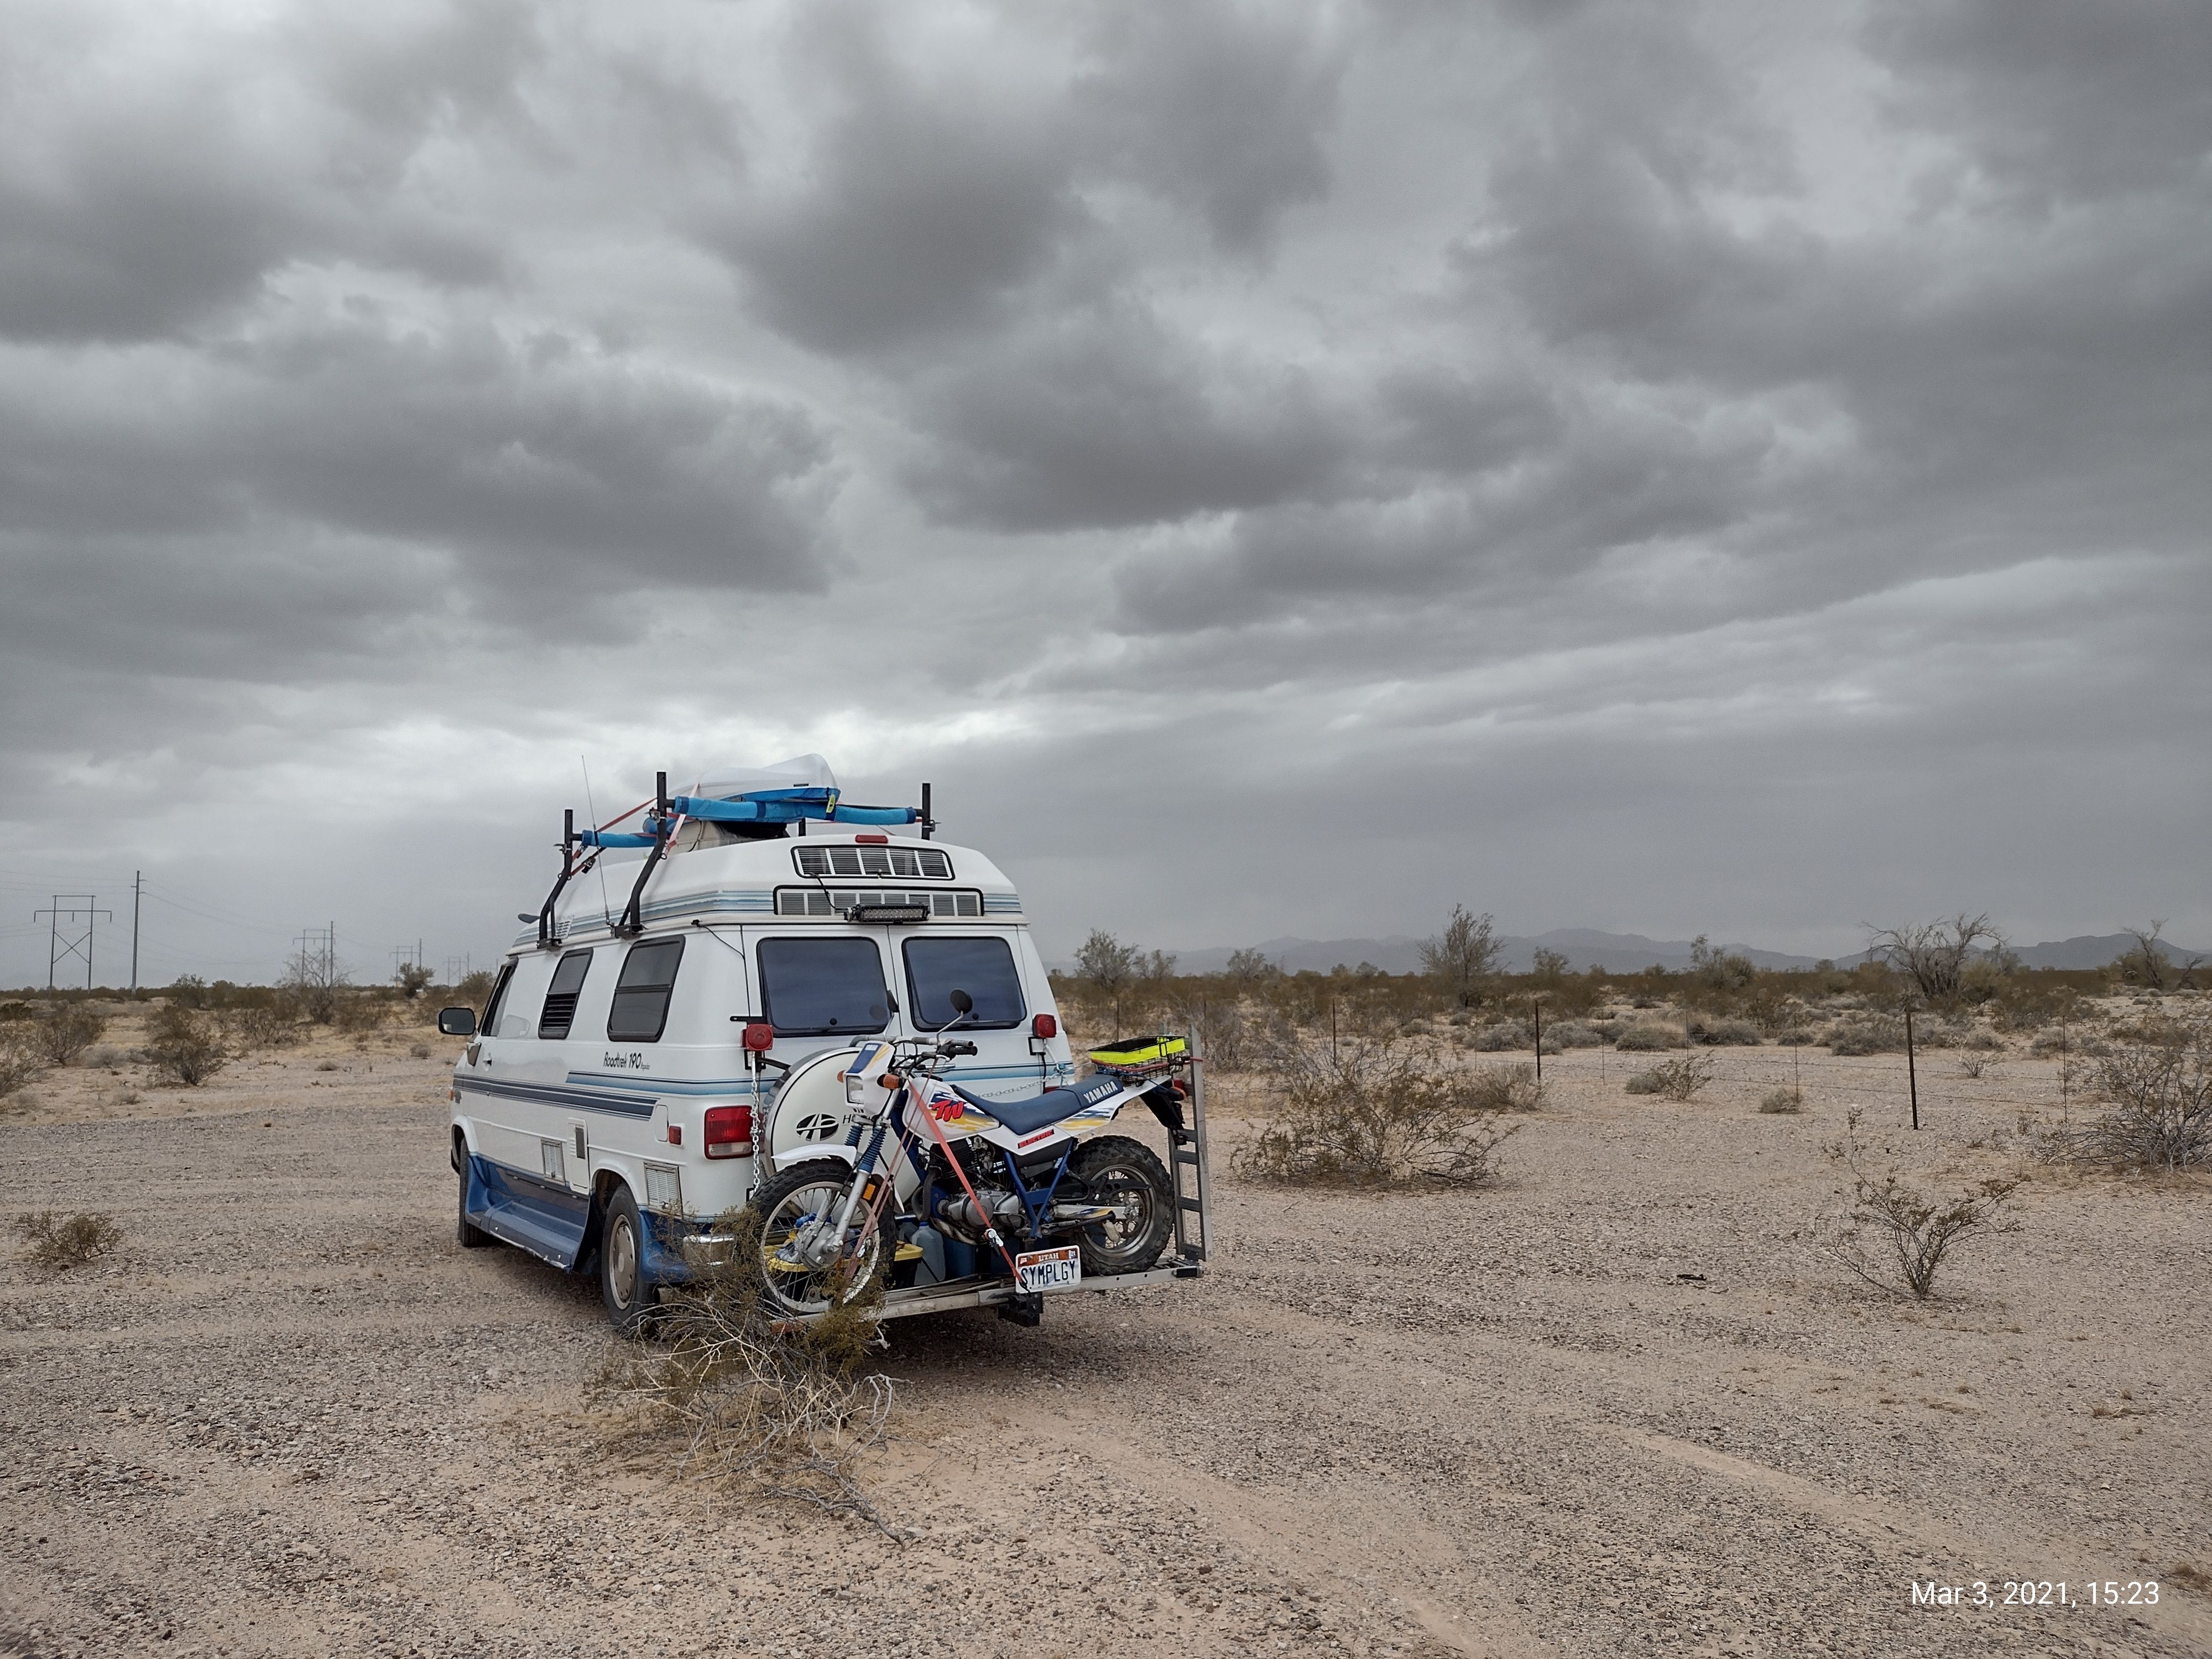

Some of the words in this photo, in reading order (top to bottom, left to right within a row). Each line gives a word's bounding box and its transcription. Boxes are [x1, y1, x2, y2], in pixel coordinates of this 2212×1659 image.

[603, 1051, 628, 1068] Roadtrek
[629, 1052, 641, 1069] 190
[1083, 1081, 1118, 1103] YAMAHA
[931, 1099, 964, 1122] TW
[1038, 1252, 1060, 1261] UTAH
[1021, 1260, 1075, 1285] SYMPLGY
